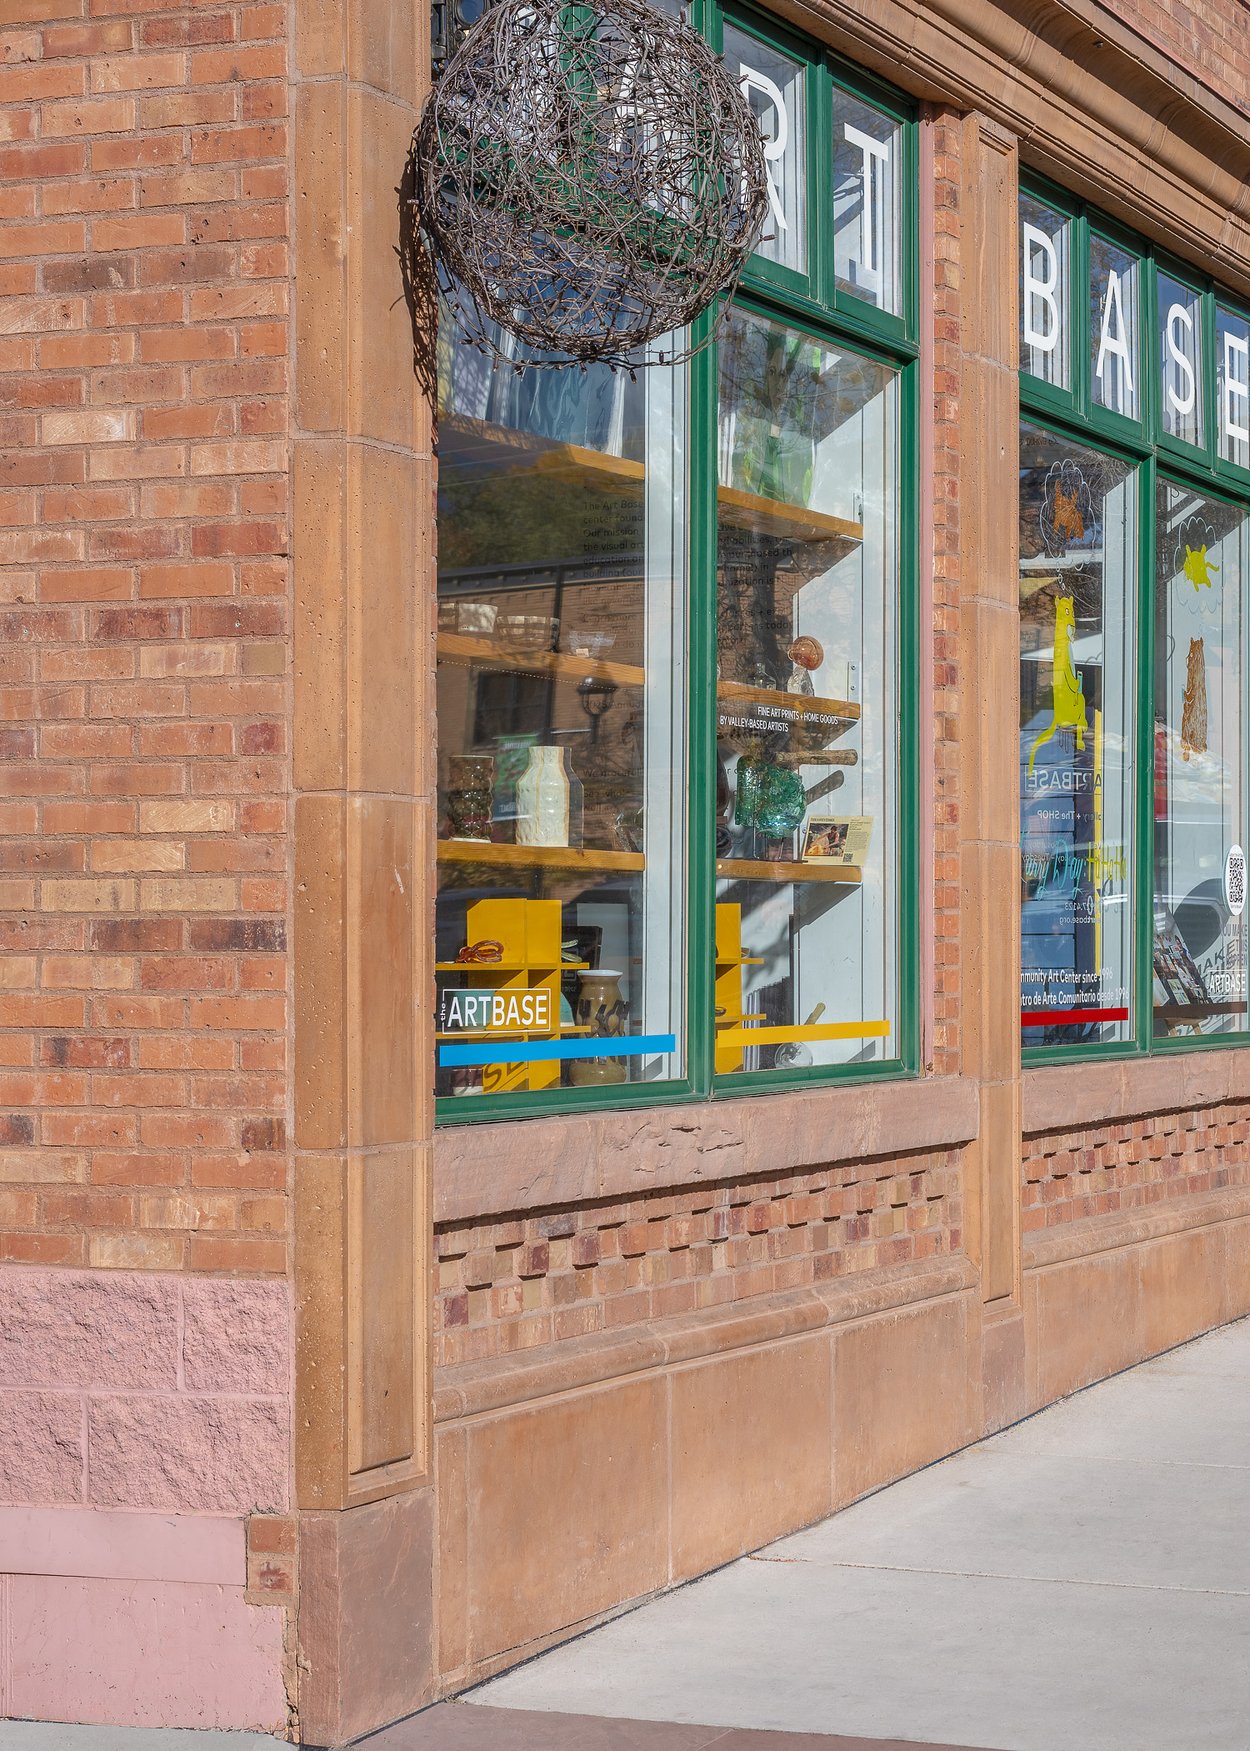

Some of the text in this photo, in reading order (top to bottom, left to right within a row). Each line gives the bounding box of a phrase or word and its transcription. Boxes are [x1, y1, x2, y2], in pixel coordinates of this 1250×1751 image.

[1023, 221, 1250, 443] BASE
[719, 715, 789, 732] BY VALLEY-BASED ARTISTS
[757, 706, 770, 717] FINE
[770, 708, 781, 718] ART
[781, 709, 799, 720] PRINTS
[804, 712, 819, 722] HOME
[819, 714, 839, 725] GOODS
[1048, 969, 1059, 983] Art
[1060, 969, 1081, 984] Center
[1082, 970, 1097, 984] since
[1209, 973, 1246, 994] ARTBASE
[1033, 991, 1042, 1006] de
[1042, 991, 1057, 1005] Arte
[1058, 988, 1096, 1005] Comunitario
[1096, 987, 1114, 1002] desde
[447, 995, 548, 1028] ARTBASE
